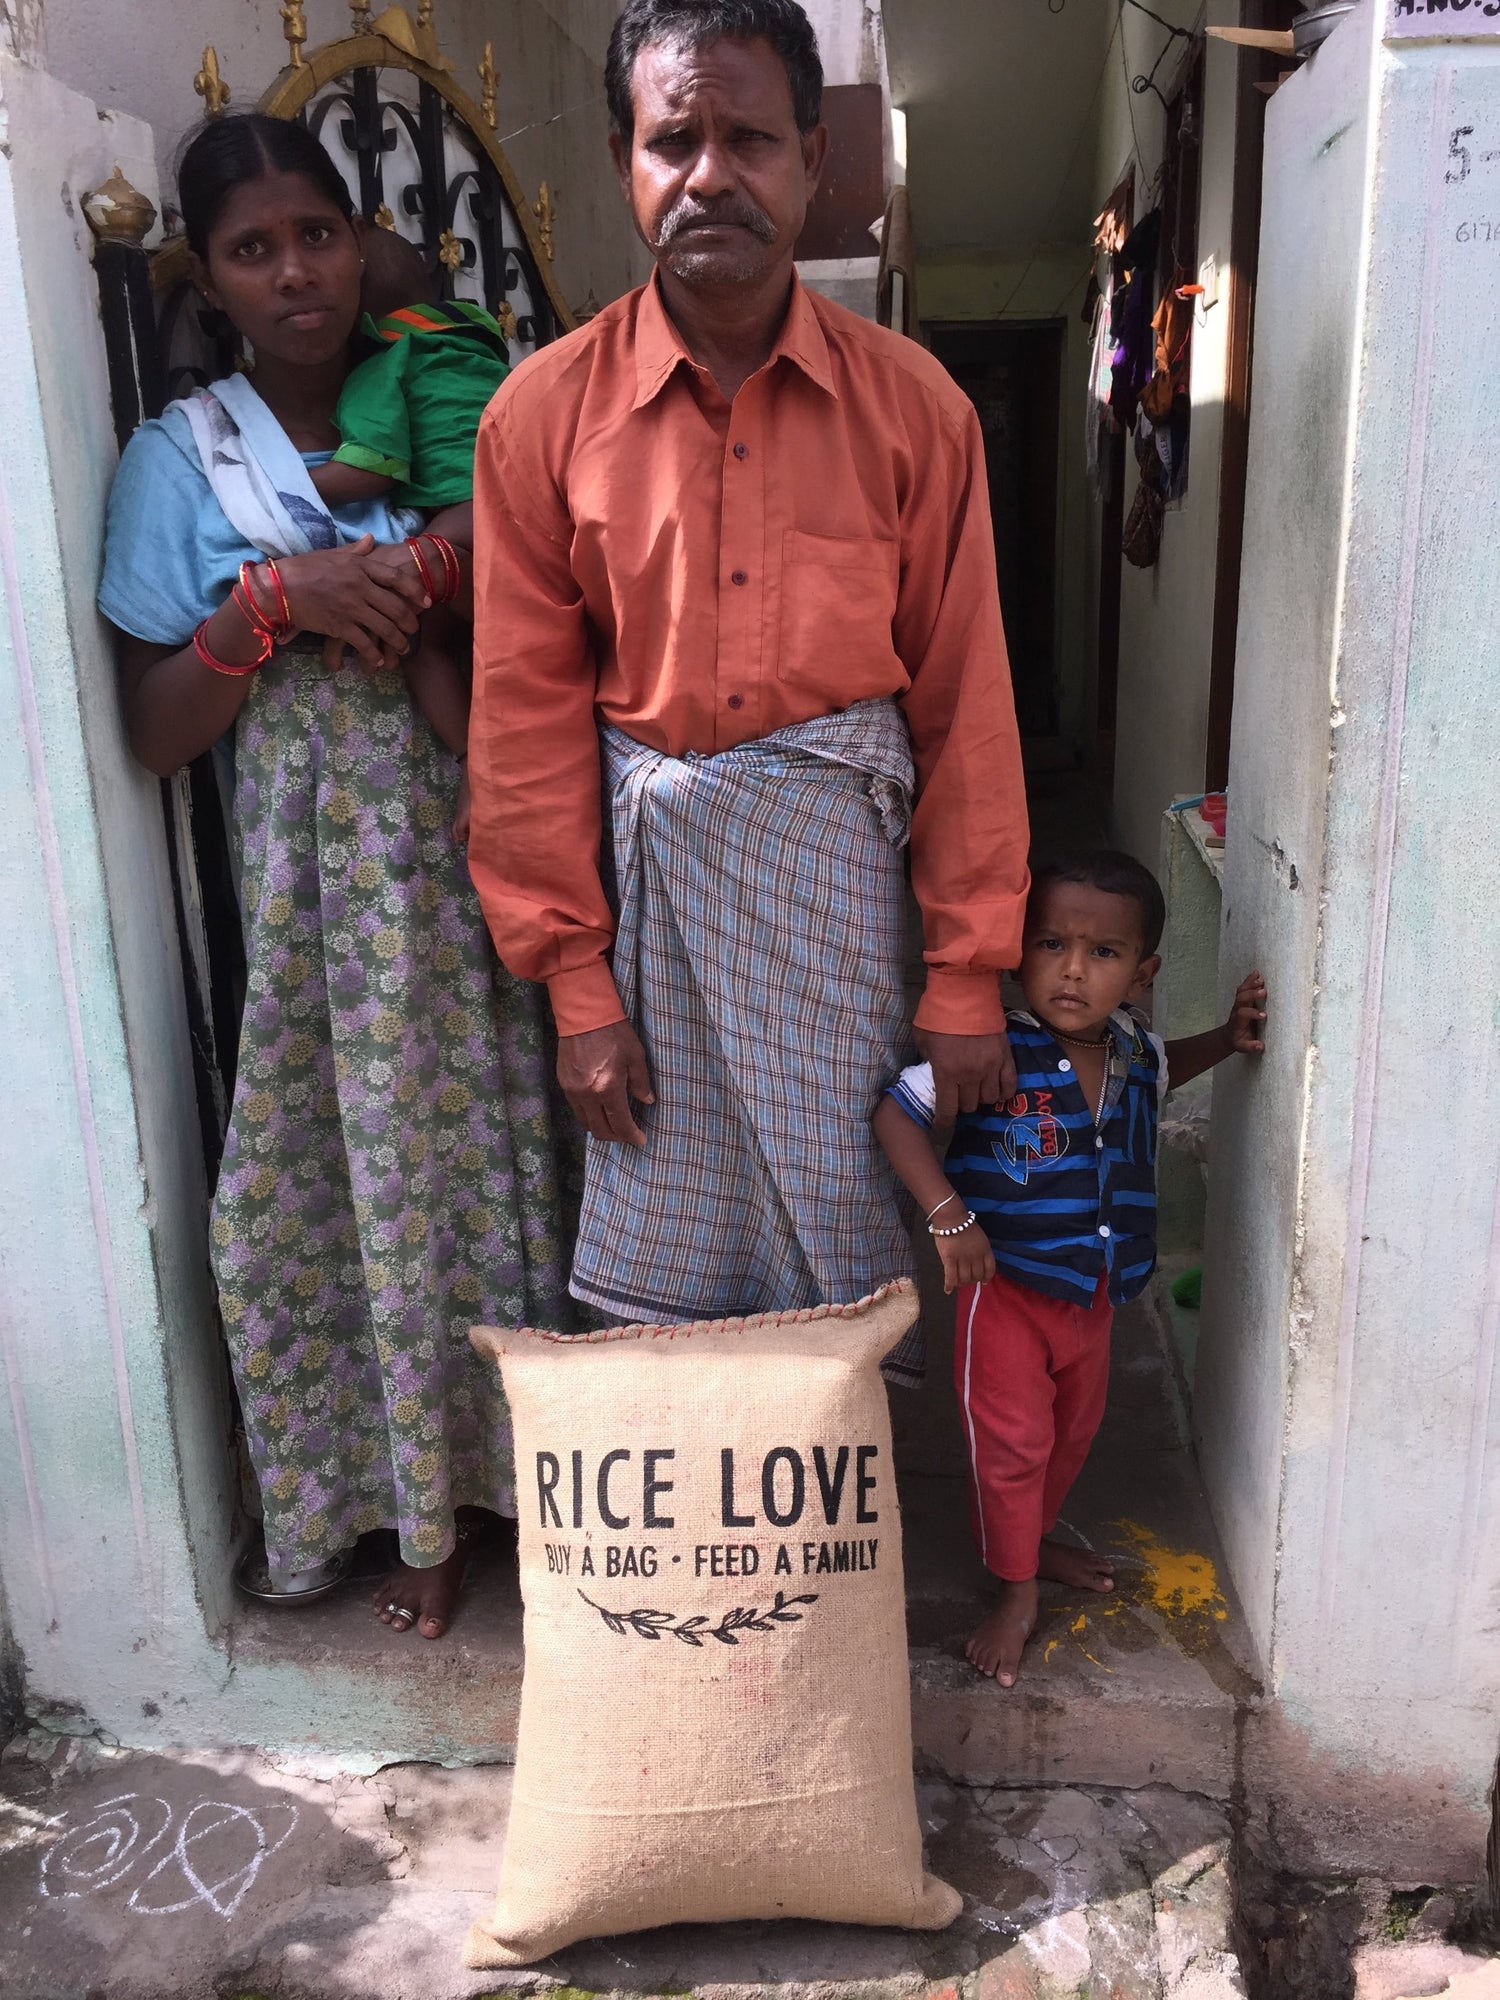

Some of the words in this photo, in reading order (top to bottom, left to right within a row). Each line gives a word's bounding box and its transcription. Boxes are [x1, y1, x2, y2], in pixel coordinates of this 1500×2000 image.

[536, 1449, 675, 1529] RICE
[721, 1445, 878, 1527] LOVE
[544, 1543, 572, 1574] BUY
[581, 1545, 596, 1576] A
[606, 1544, 658, 1577] BAG
[695, 1544, 759, 1577] FEED
[774, 1543, 792, 1575] A
[803, 1539, 879, 1575] FAMILY
